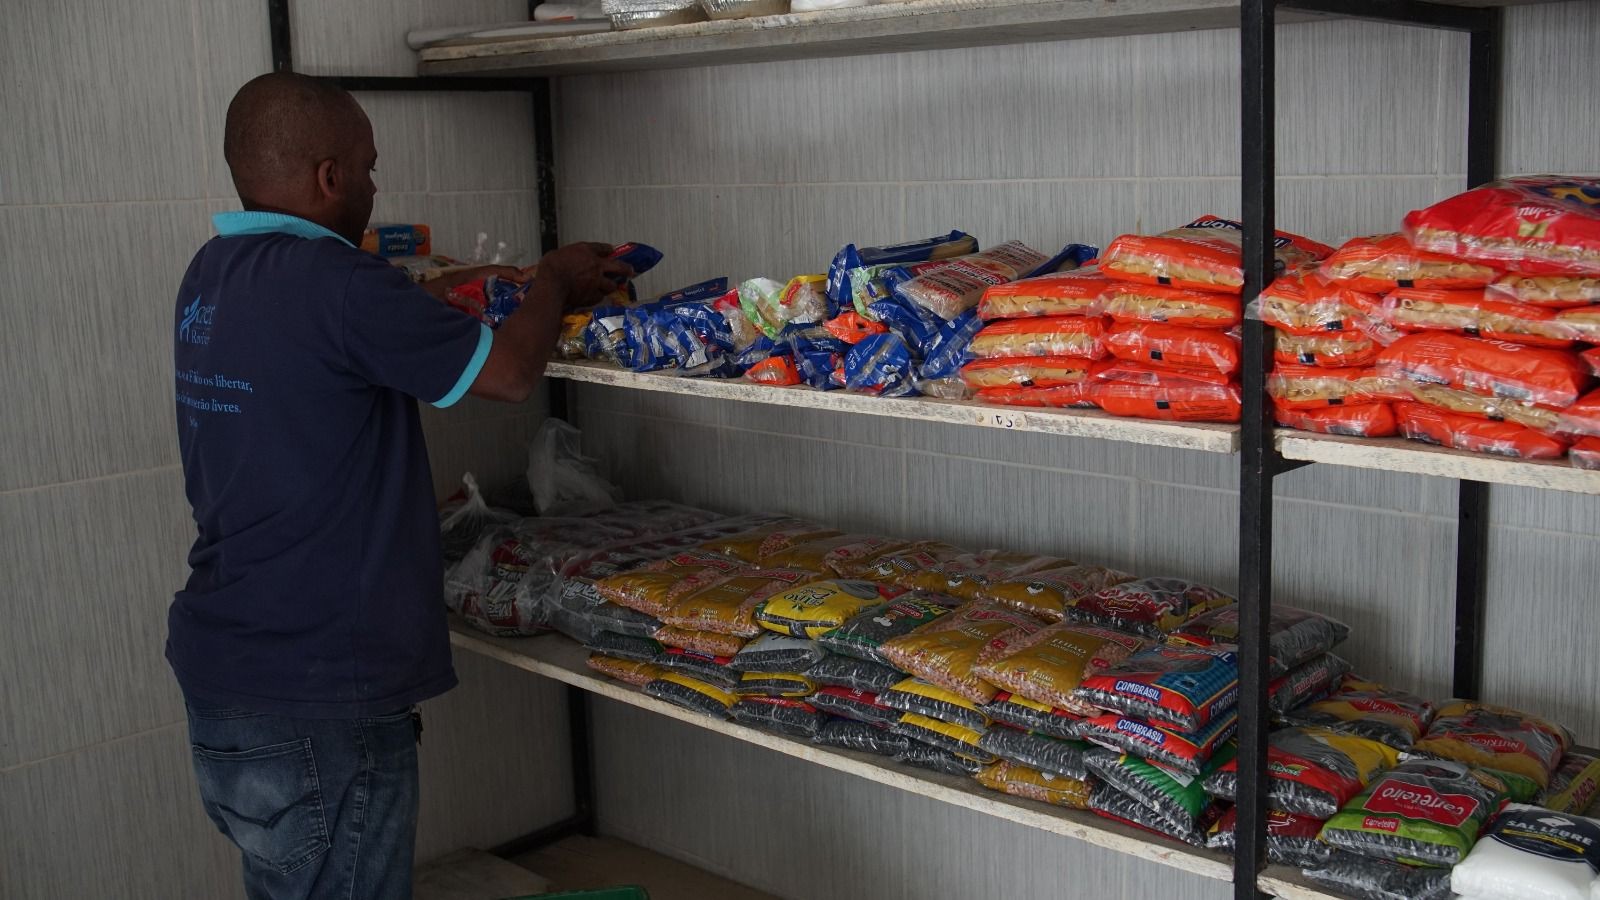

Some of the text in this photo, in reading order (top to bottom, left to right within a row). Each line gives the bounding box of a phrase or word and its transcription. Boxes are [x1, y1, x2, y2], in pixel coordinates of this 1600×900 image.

[215, 373, 254, 393] libertar,
[211, 398, 242, 414] livres.
[1115, 680, 1160, 702] COMBRASIL
[1117, 719, 1163, 743] COMBRASIL
[1382, 787, 1465, 816] carreteiro
[1505, 820, 1537, 831] SAL
[1540, 824, 1594, 845] LEBRE
